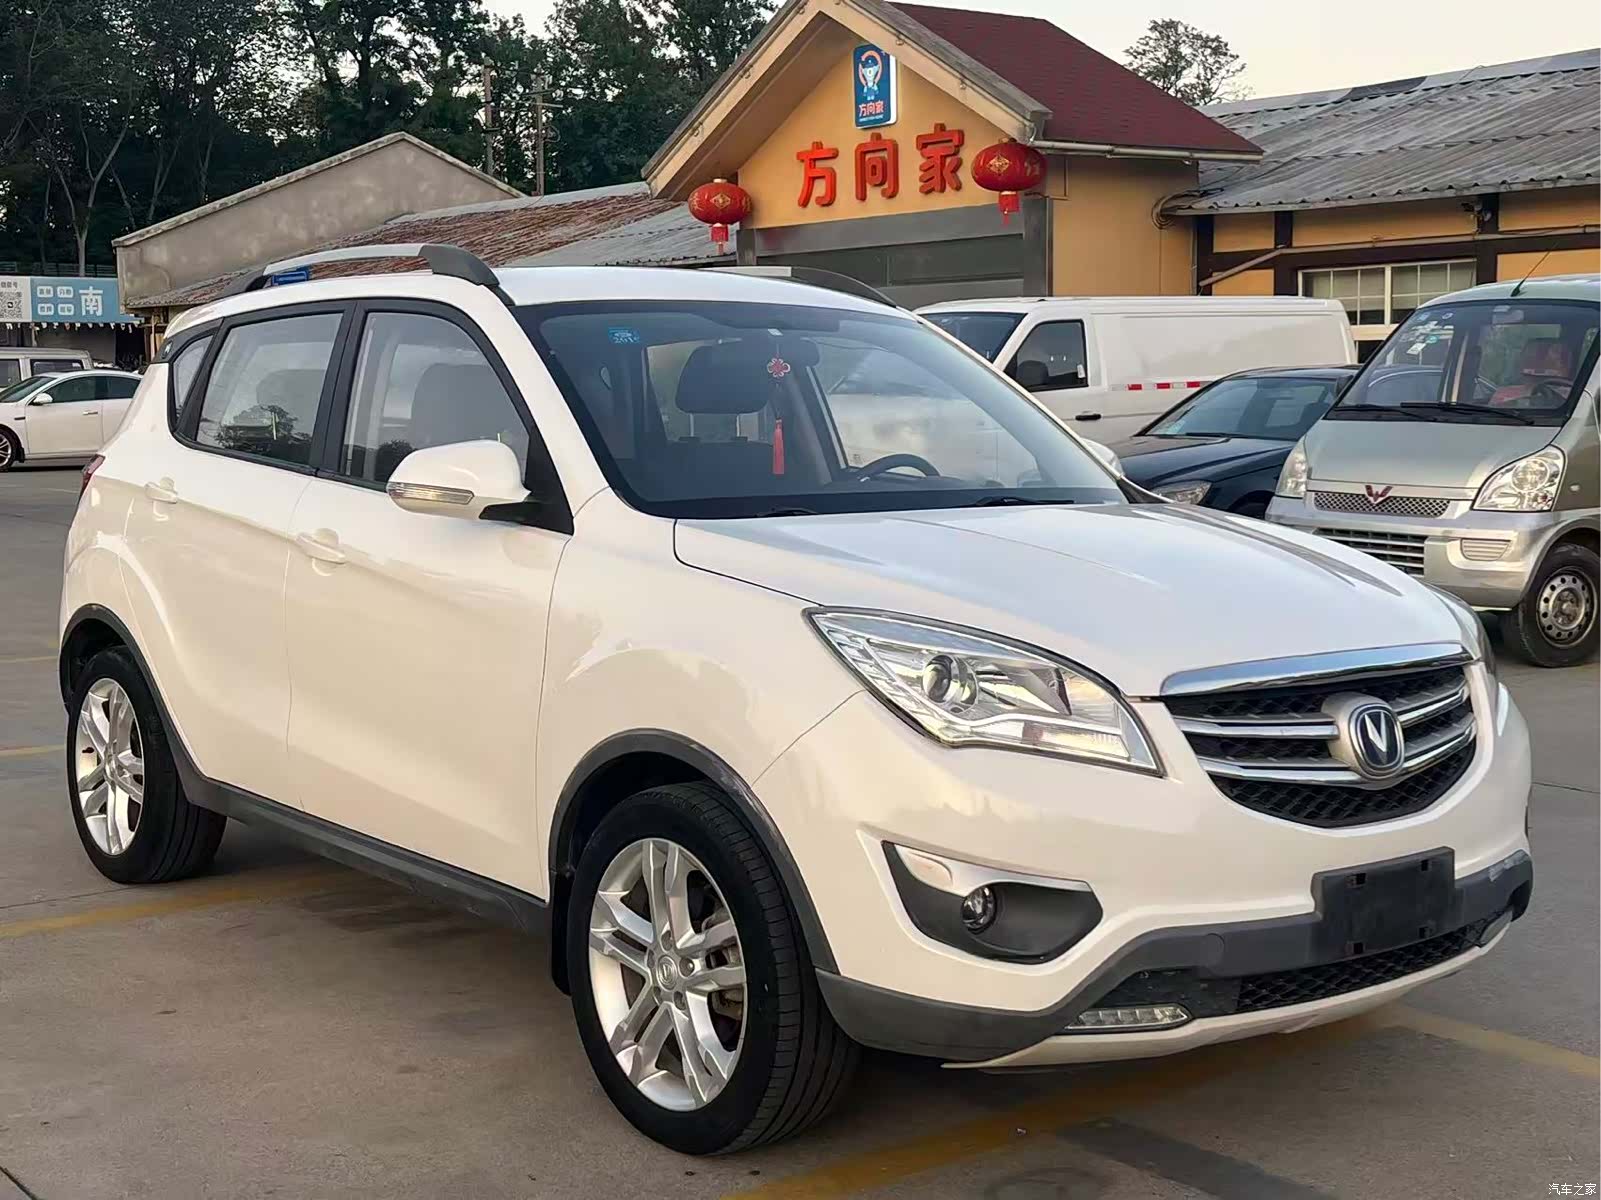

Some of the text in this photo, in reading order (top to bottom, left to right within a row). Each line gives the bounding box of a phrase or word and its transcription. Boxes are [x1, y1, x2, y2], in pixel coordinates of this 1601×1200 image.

[858, 100, 884, 117] 方向家
[796, 122, 965, 208] 方向家
[79, 286, 104, 316] 南
